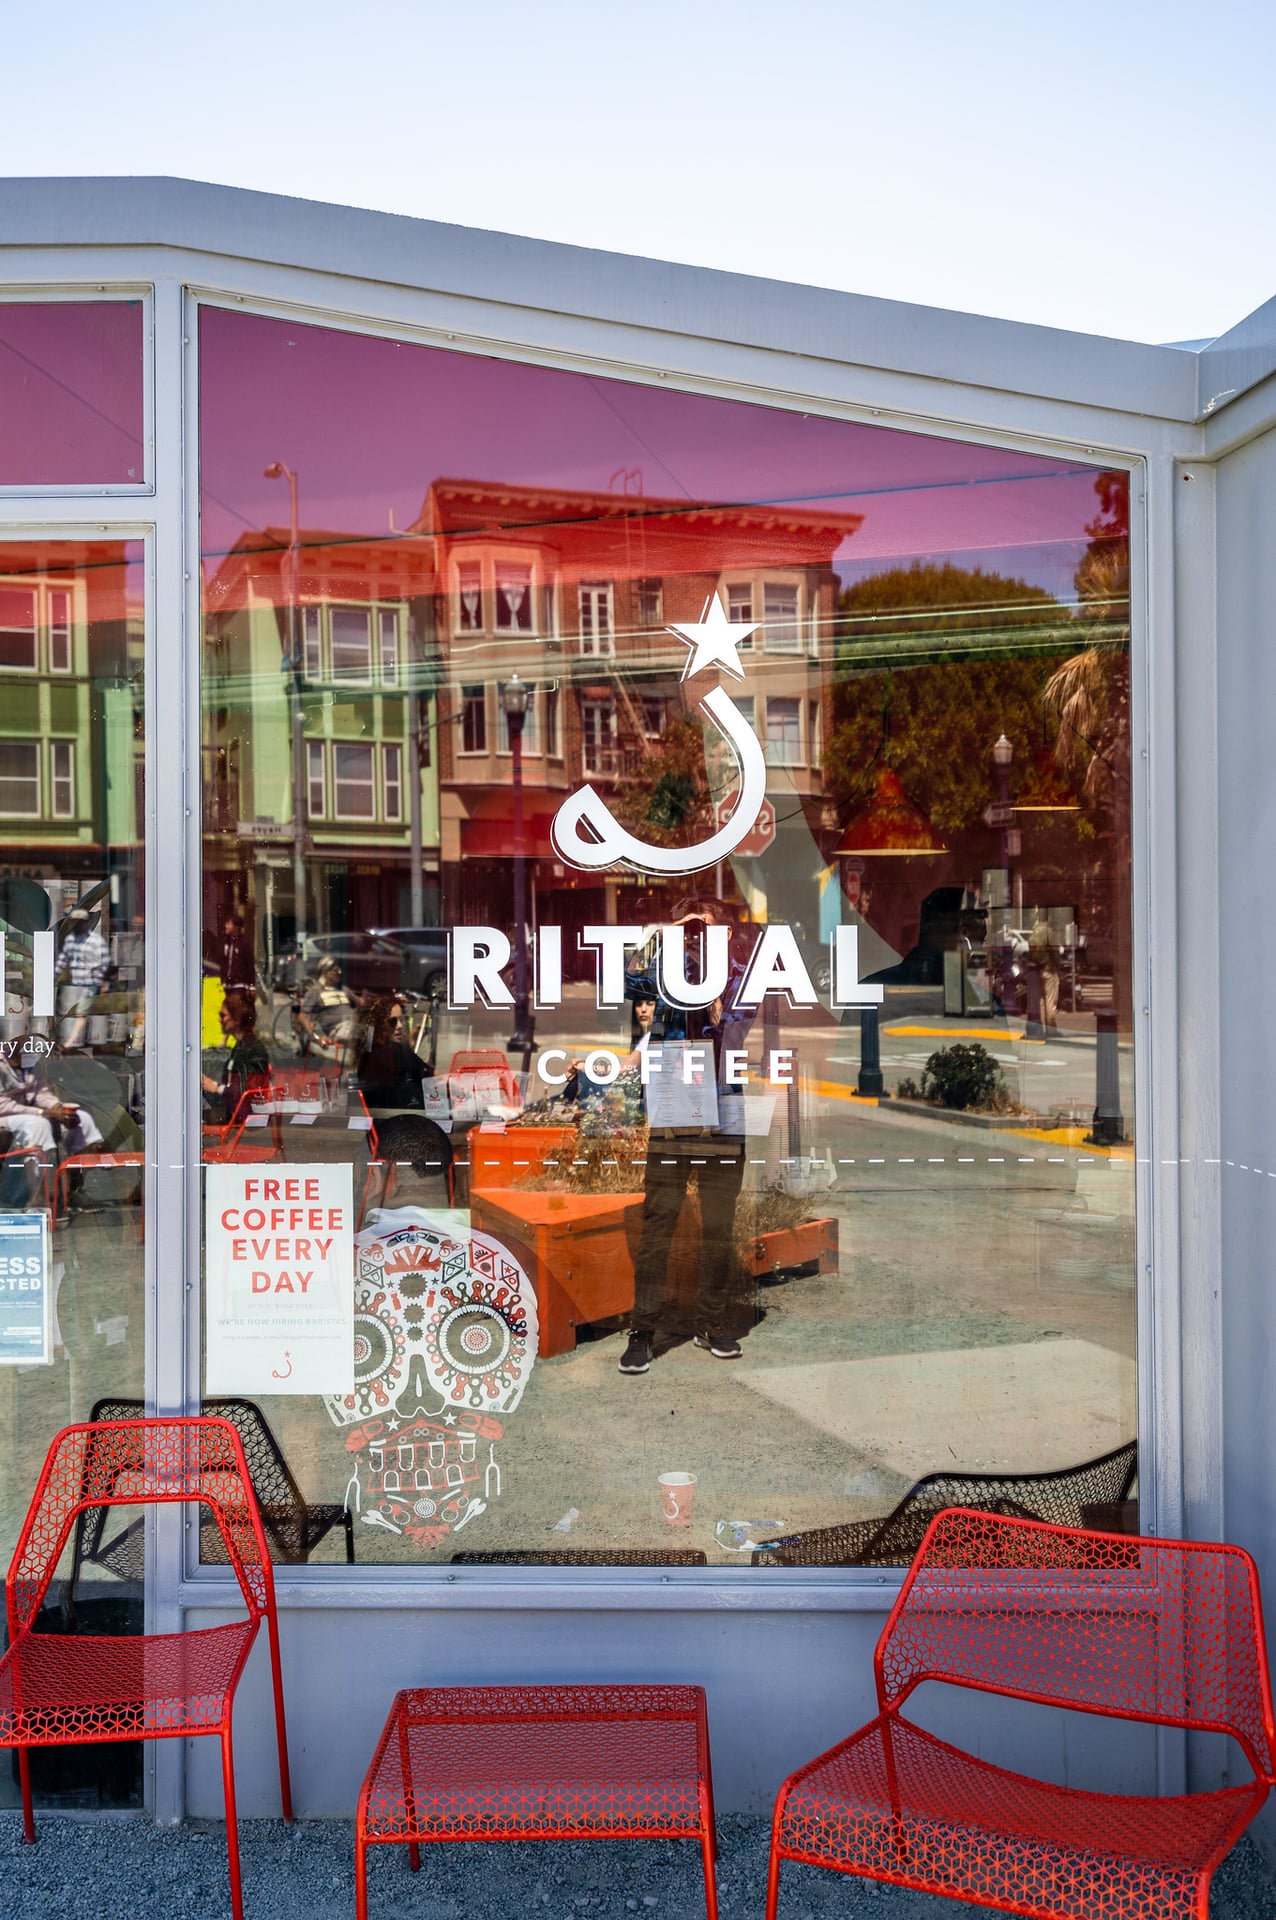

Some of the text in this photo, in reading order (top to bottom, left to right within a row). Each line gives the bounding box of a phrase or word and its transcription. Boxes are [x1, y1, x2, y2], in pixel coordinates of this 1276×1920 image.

[447, 925, 884, 1010] RITUAL
[23, 1036, 55, 1058] day
[537, 1049, 795, 1086] COFFEE
[244, 1178, 320, 1202] FREE
[220, 1207, 343, 1232] COFFEE
[231, 1237, 334, 1261] EVERY
[251, 1271, 314, 1294] DAY
[247, 1317, 270, 1326] NOW
[271, 1317, 304, 1326] HIRING
[305, 1317, 346, 1325] BARISTAS
